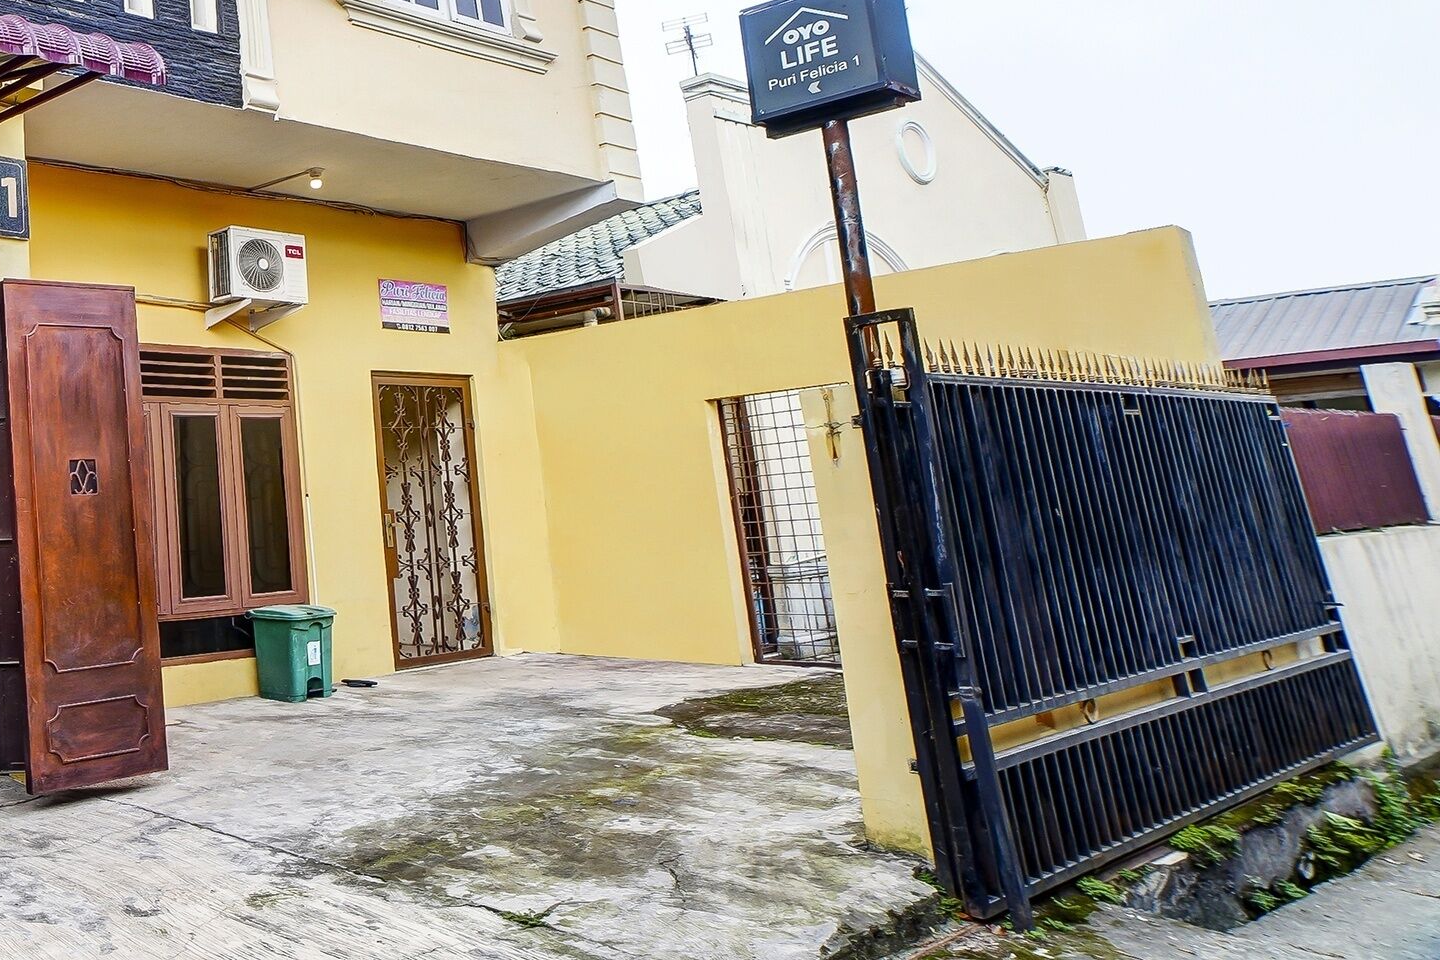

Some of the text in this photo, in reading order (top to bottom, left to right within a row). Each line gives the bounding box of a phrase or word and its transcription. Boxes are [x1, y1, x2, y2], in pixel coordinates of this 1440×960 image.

[782, 20, 830, 45] OYO
[780, 35, 839, 70] LIFE
[768, 55, 860, 91] Puri Felicia 1
[1, 176, 18, 218] 1
[287, 248, 301, 256] TCL
[381, 280, 447, 301] Puri Felicia
